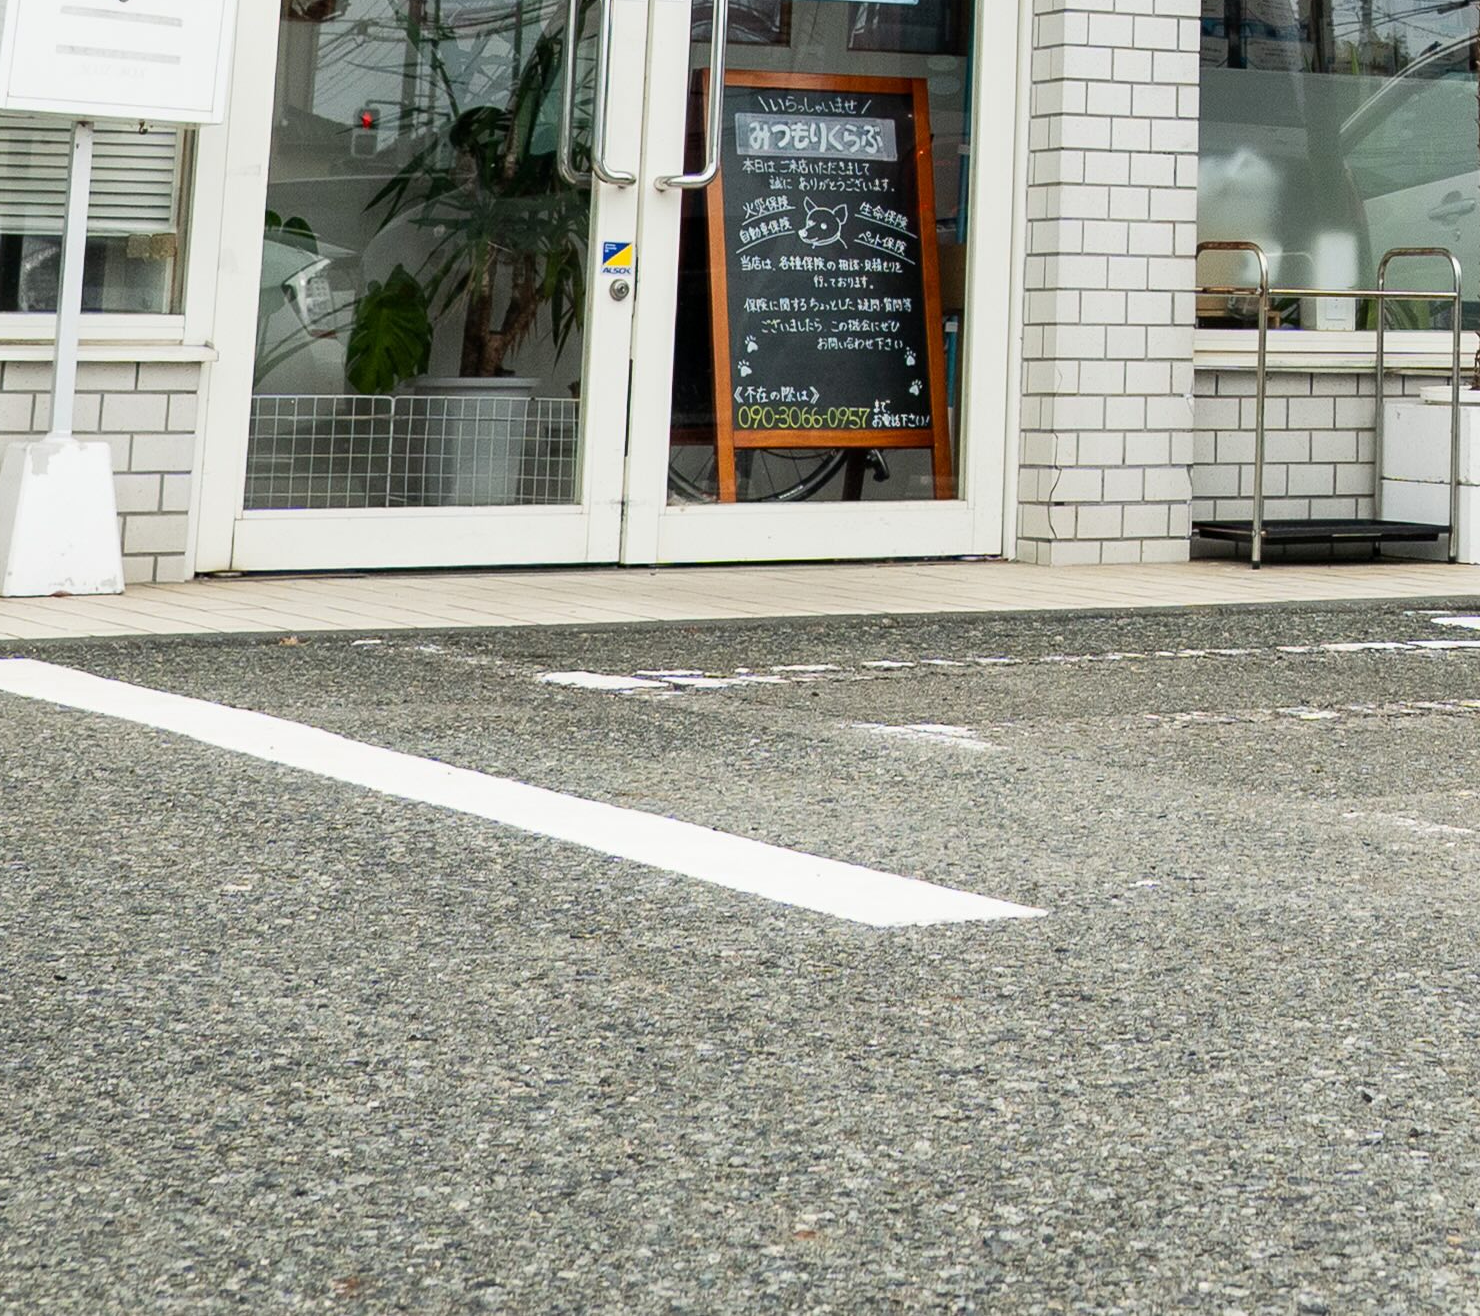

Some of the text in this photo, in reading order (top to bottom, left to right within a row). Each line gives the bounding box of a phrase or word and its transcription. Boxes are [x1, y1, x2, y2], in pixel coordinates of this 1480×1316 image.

[748, 121, 884, 155] みつもりくらぶ
[742, 195, 791, 219] 火災保険
[859, 201, 909, 232] 生命保険
[739, 216, 793, 243] 自動車保険
[859, 230, 908, 257] ペット保険
[603, 267, 632, 275] ALSOK
[738, 405, 871, 429] 090-3066-0957
